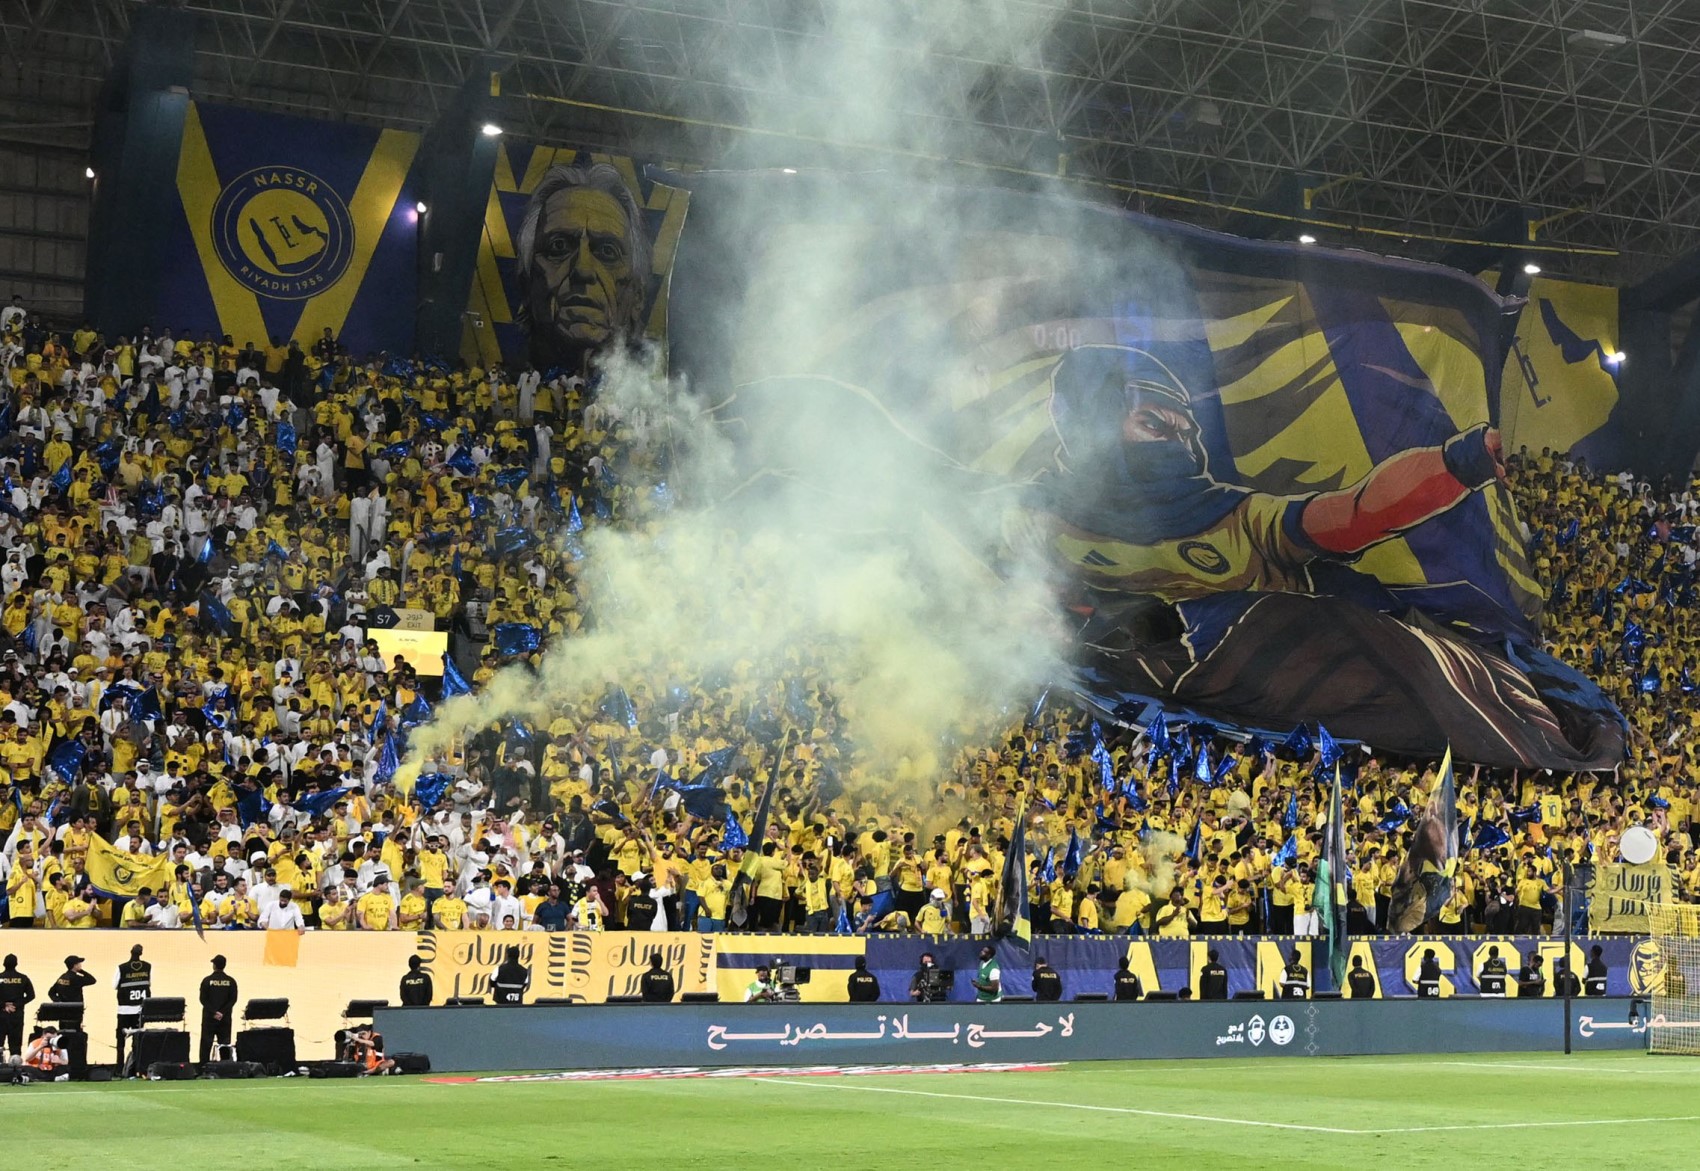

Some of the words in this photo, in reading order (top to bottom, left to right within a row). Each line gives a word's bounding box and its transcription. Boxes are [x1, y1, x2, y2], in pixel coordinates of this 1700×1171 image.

[253, 173, 318, 195] NASSR
[240, 265, 290, 292] RIYADH
[295, 274, 324, 291] 1955
[377, 614, 391, 625] S7
[407, 621, 421, 629] EXIT
[633, 902, 653, 910] POLICE
[130, 989, 147, 1000] 204
[707, 1014, 887, 1050] تصريح
[891, 1013, 960, 1045] بلا
[966, 1021, 1053, 1048] حج
[1058, 1012, 1075, 1037] لا
